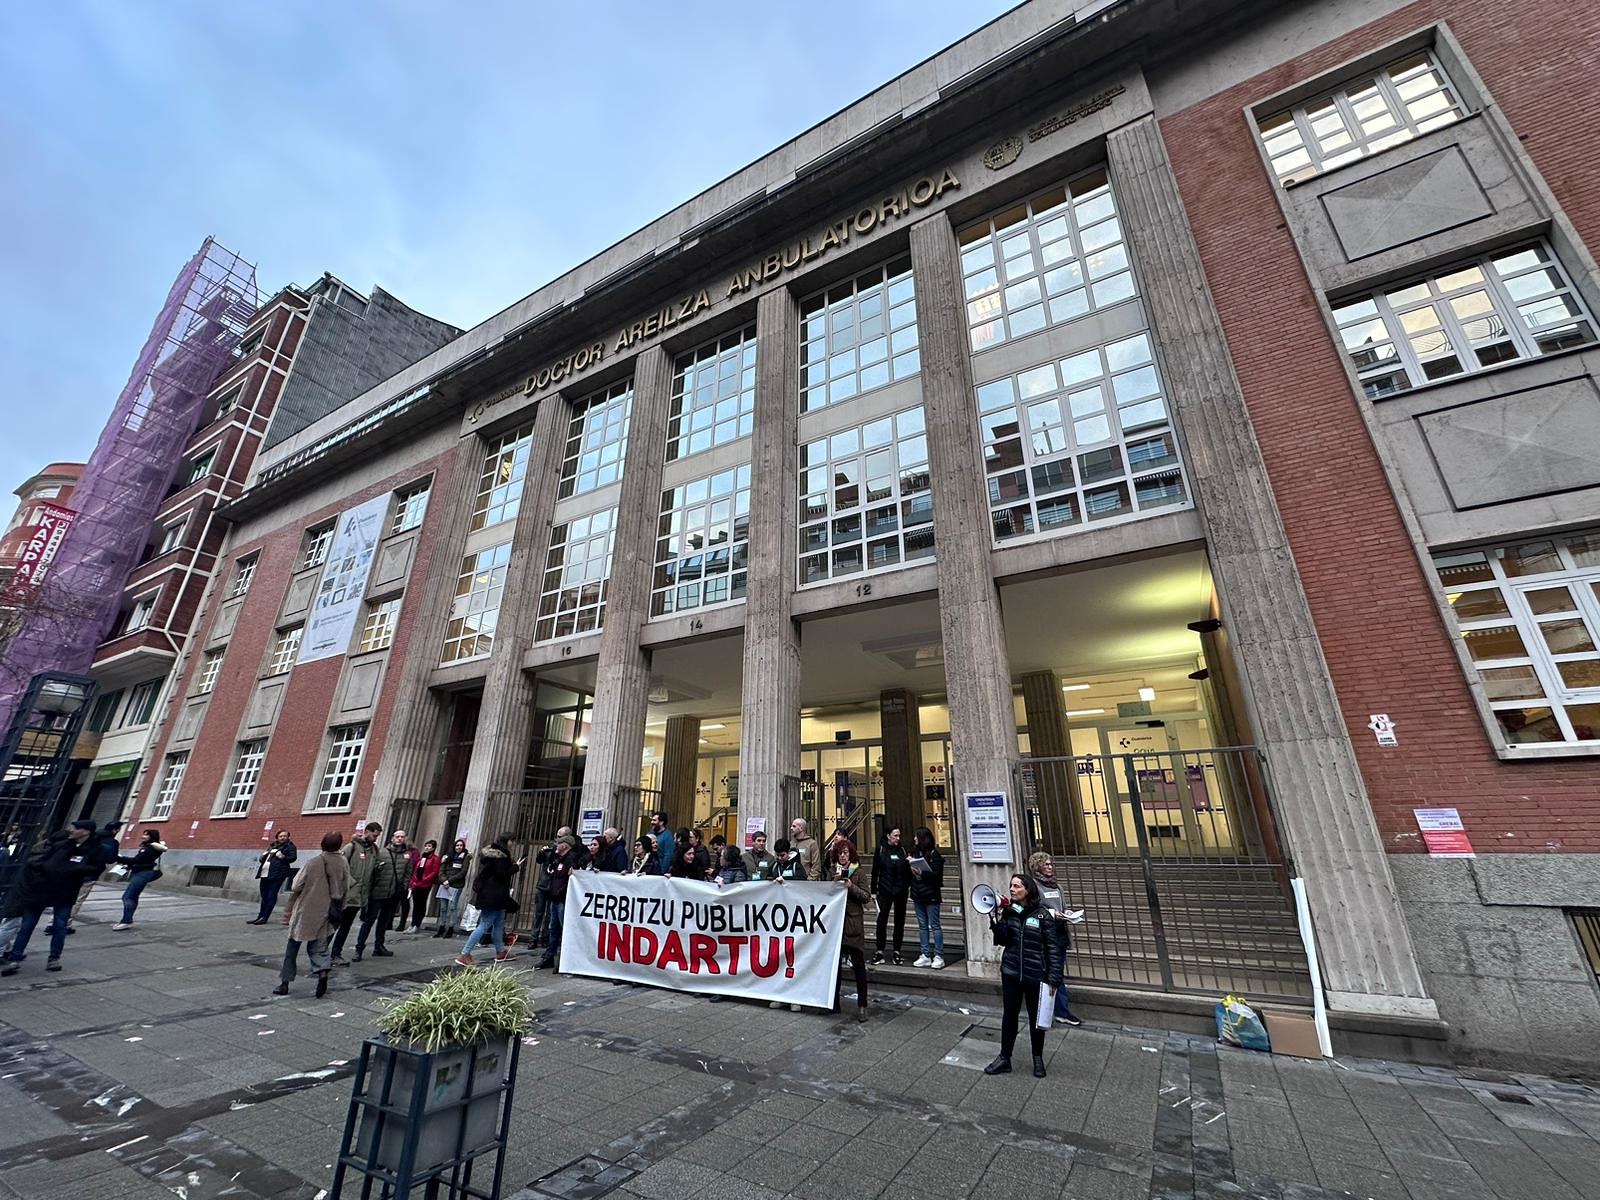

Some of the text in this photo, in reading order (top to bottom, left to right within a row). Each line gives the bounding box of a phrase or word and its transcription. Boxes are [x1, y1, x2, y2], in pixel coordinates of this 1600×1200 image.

[524, 167, 961, 397] DOCTOR AREILZA ANBULATORIOA
[17, 516, 55, 577] KARPA
[856, 584, 872, 597] 12
[690, 619, 703, 631] 14
[561, 646, 572, 656] 16
[580, 893, 827, 934] ZERBITZU PUBLIKOAK
[597, 922, 795, 978] INDARTU!
